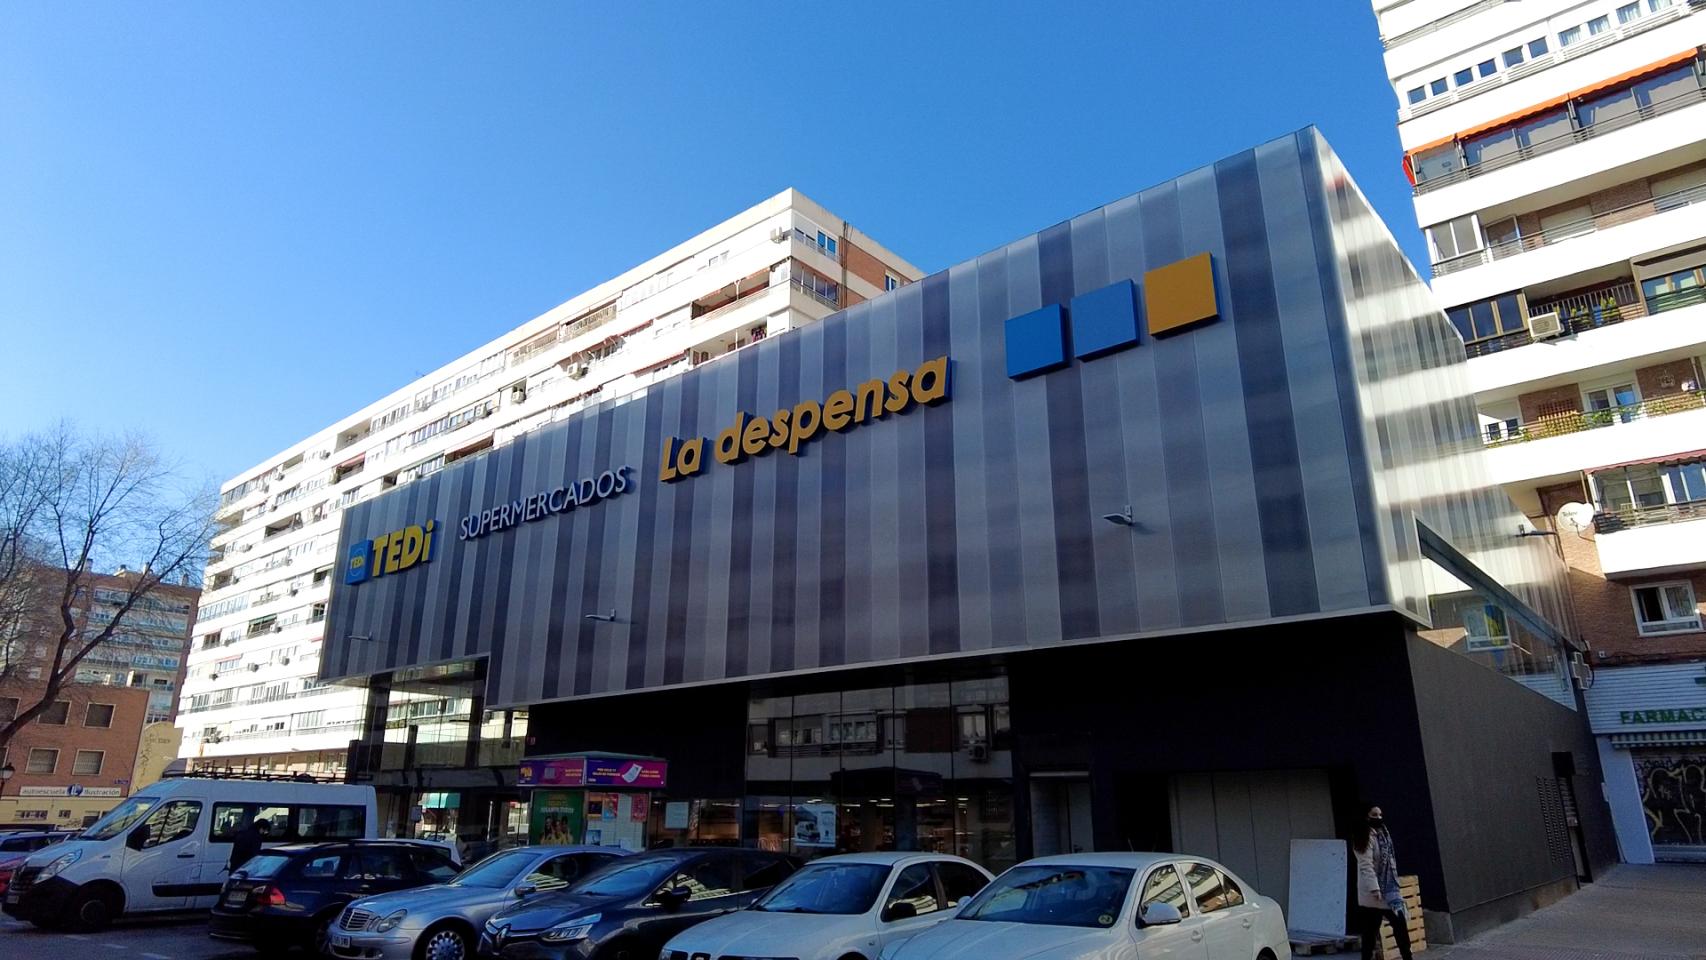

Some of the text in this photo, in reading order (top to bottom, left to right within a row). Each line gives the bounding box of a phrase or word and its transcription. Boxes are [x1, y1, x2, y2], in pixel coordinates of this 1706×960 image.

[660, 355, 949, 481] La despensa
[459, 465, 629, 541] SUPERMERCADOS
[372, 518, 434, 577] TEDi
